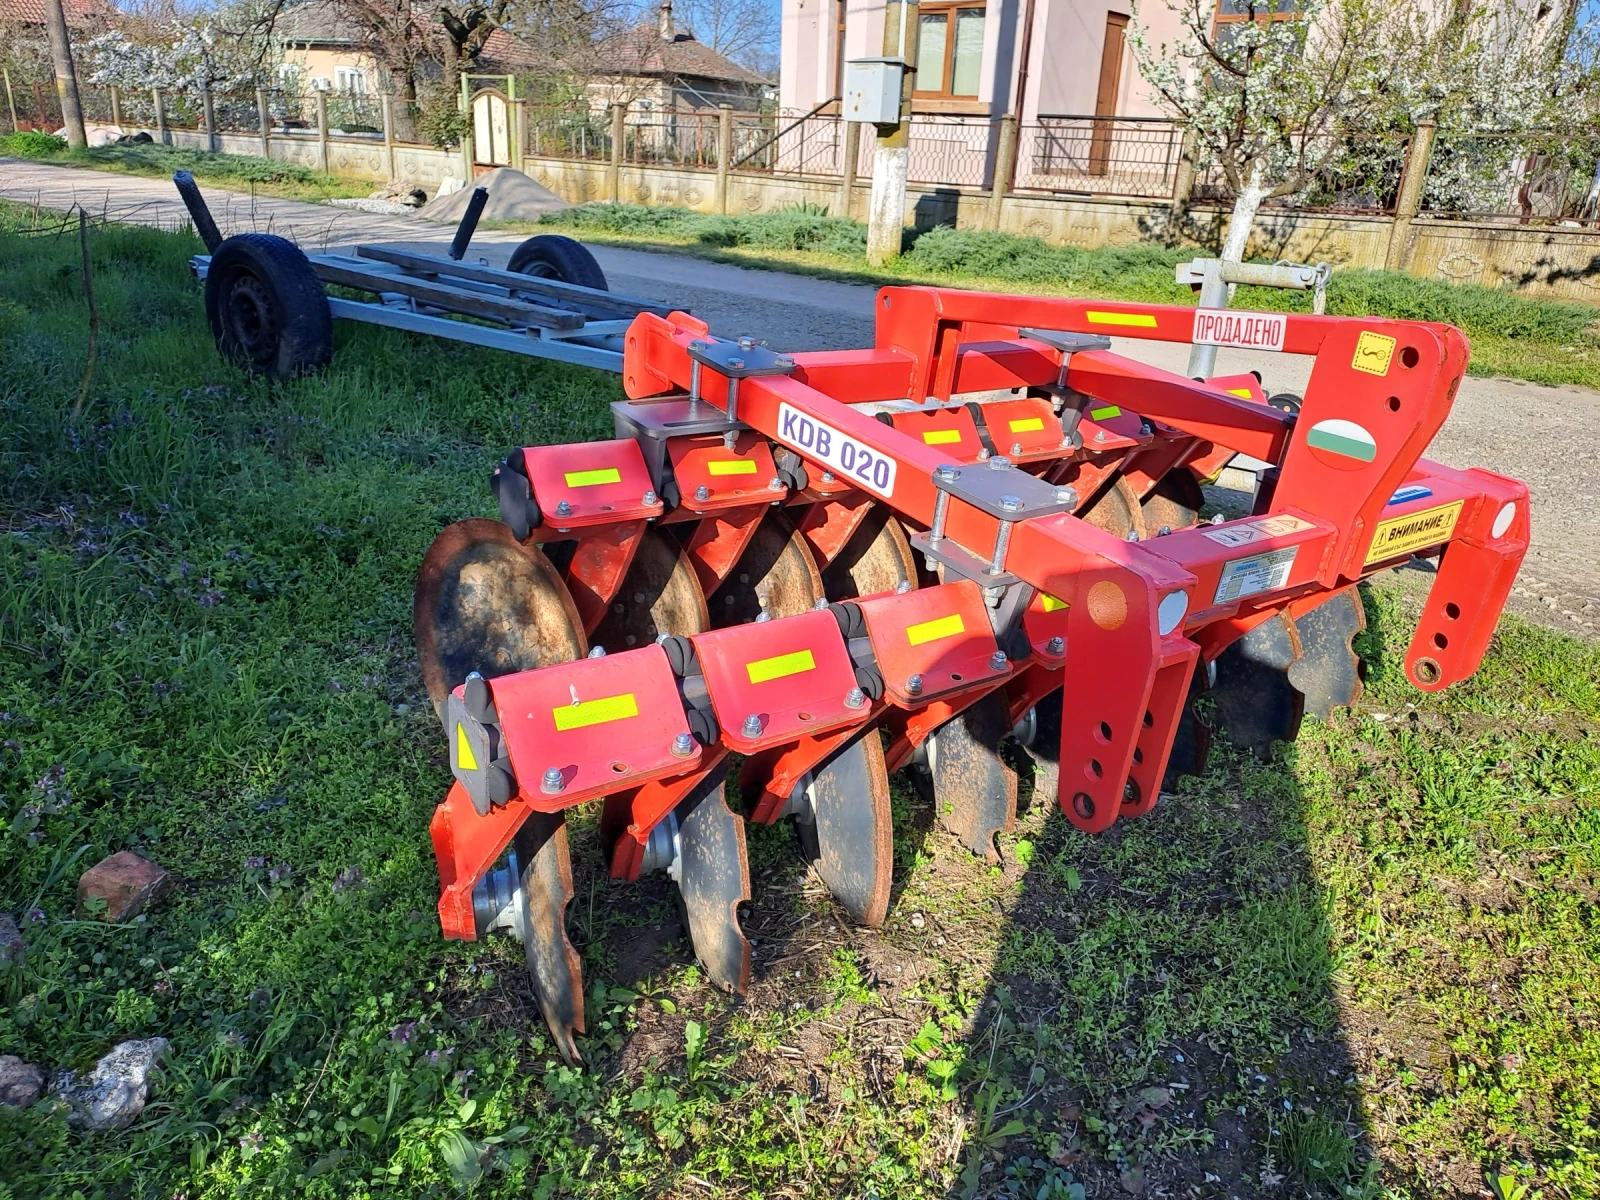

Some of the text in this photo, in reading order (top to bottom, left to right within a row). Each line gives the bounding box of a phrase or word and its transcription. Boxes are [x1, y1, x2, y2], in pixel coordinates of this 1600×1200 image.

[1196, 315, 1281, 346] ПРОДАДЕНО
[783, 409, 890, 489] KDB 020
[1388, 514, 1444, 542] ВНИМАНИЕ
